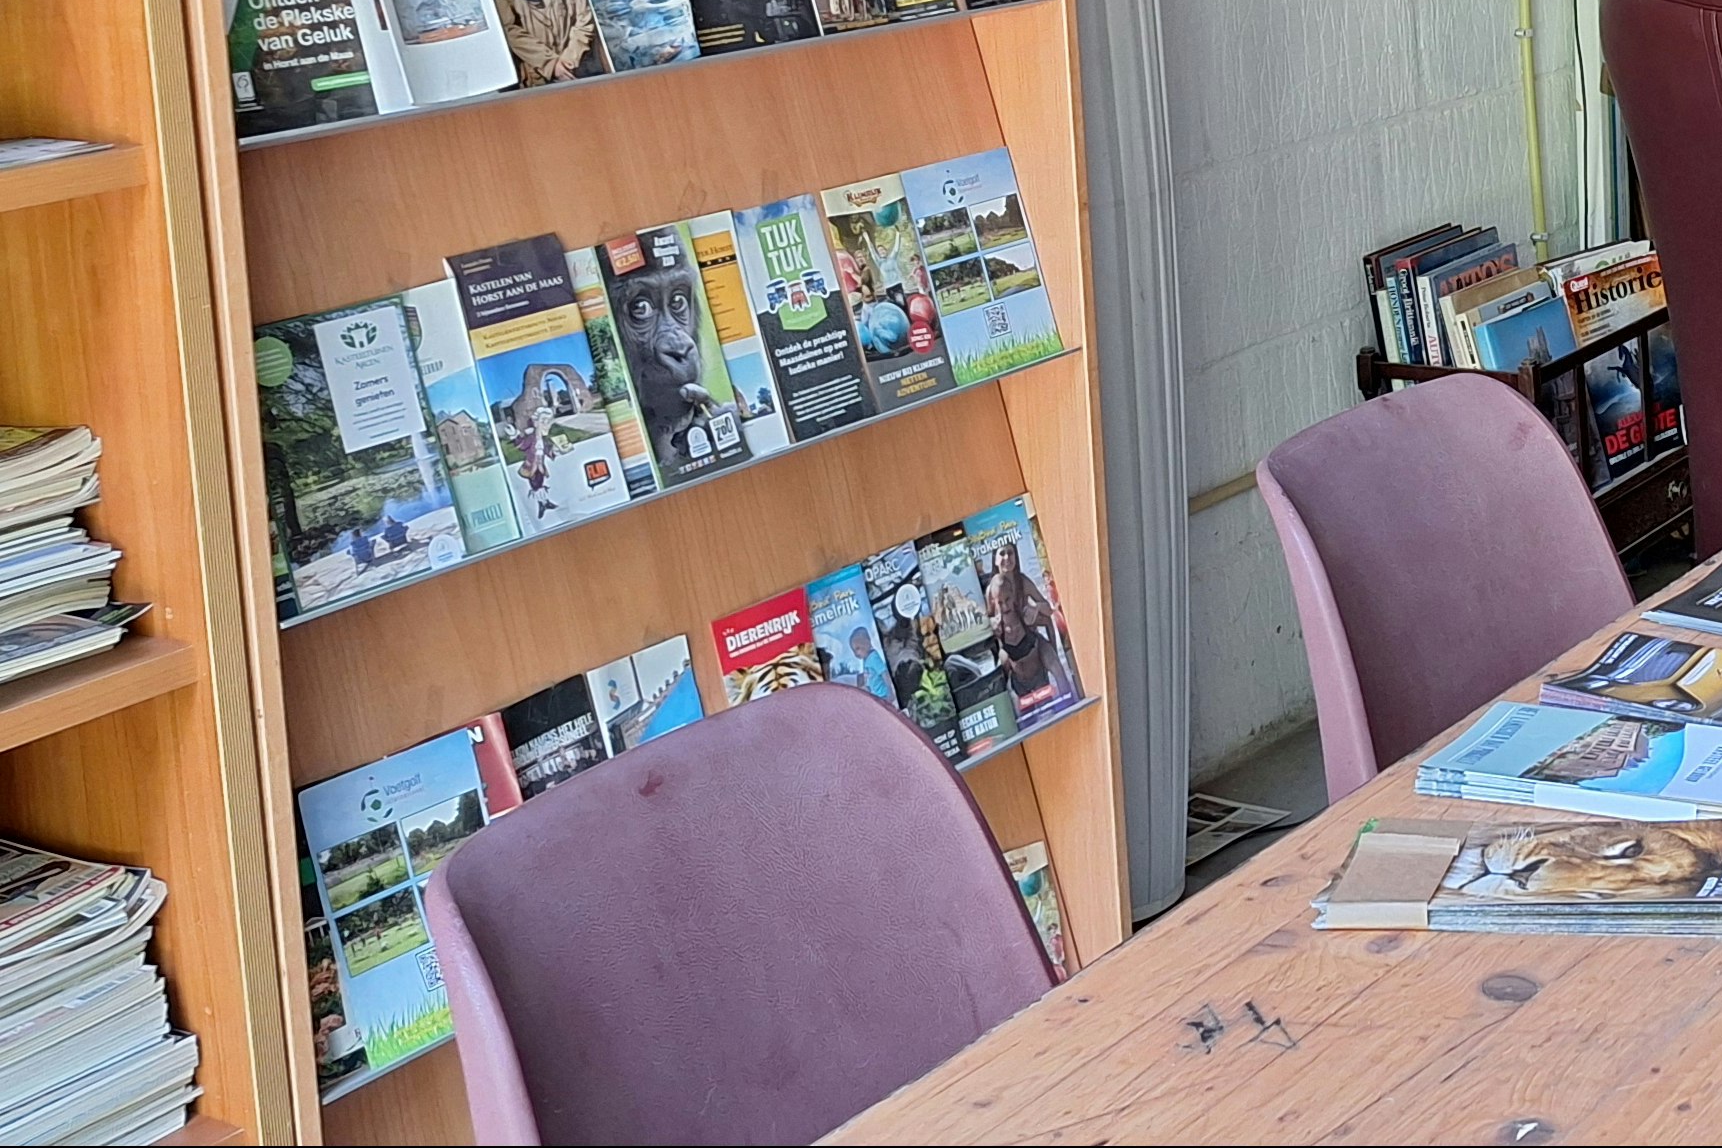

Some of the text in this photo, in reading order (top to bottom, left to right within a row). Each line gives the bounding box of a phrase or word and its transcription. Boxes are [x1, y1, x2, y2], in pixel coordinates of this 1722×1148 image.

[253, 3, 356, 31] de Plekske
[257, 23, 355, 52] van Geluk
[760, 218, 801, 248] TUK
[767, 245, 808, 271] TUK
[467, 273, 514, 296] KASTELEN
[471, 275, 564, 307] HORST AAN DE MAAS
[1573, 266, 1662, 315] Historie
[774, 329, 848, 358] Ontdek de prachtige
[788, 359, 815, 377] ludieke
[352, 374, 389, 392] Zomers
[354, 388, 396, 409] genieten
[1604, 429, 1630, 455] DE
[864, 556, 901, 583] OPARC
[724, 609, 802, 651] DIERENRIJK
[960, 709, 982, 729] ECKEN
[383, 772, 423, 797] Voetgolf
